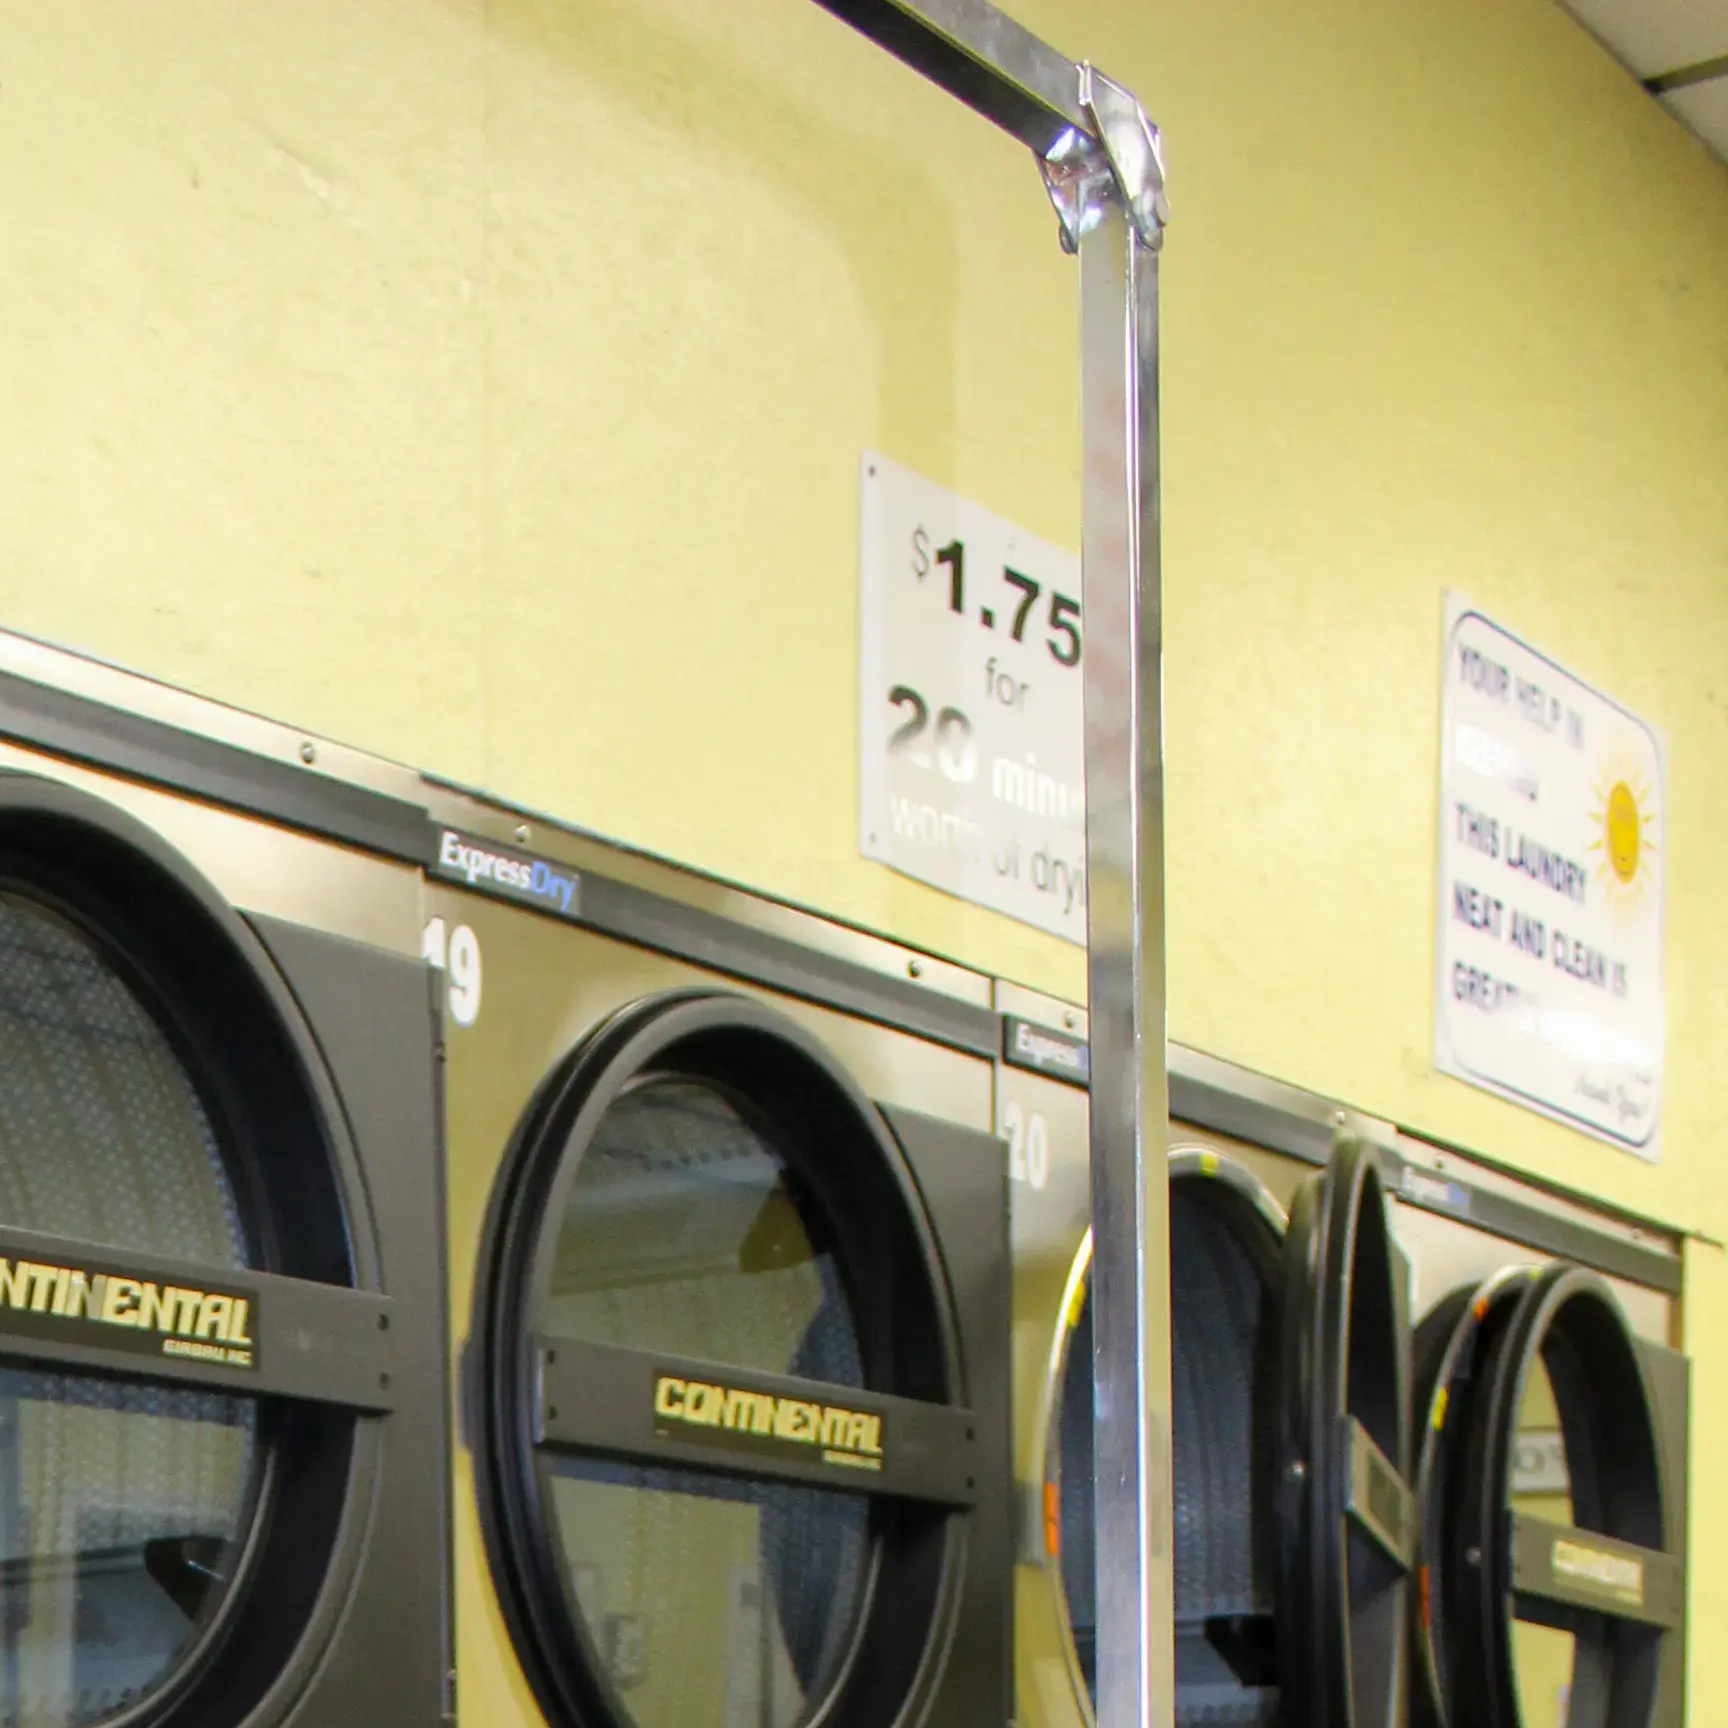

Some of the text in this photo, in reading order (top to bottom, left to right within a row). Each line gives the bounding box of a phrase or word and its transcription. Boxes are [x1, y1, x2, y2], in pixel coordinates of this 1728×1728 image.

[985, 656, 1030, 712] for
[887, 684, 978, 784] 20
[439, 830, 579, 913] ExpressDry
[655, 1377, 883, 1454] CONTINENTAL
